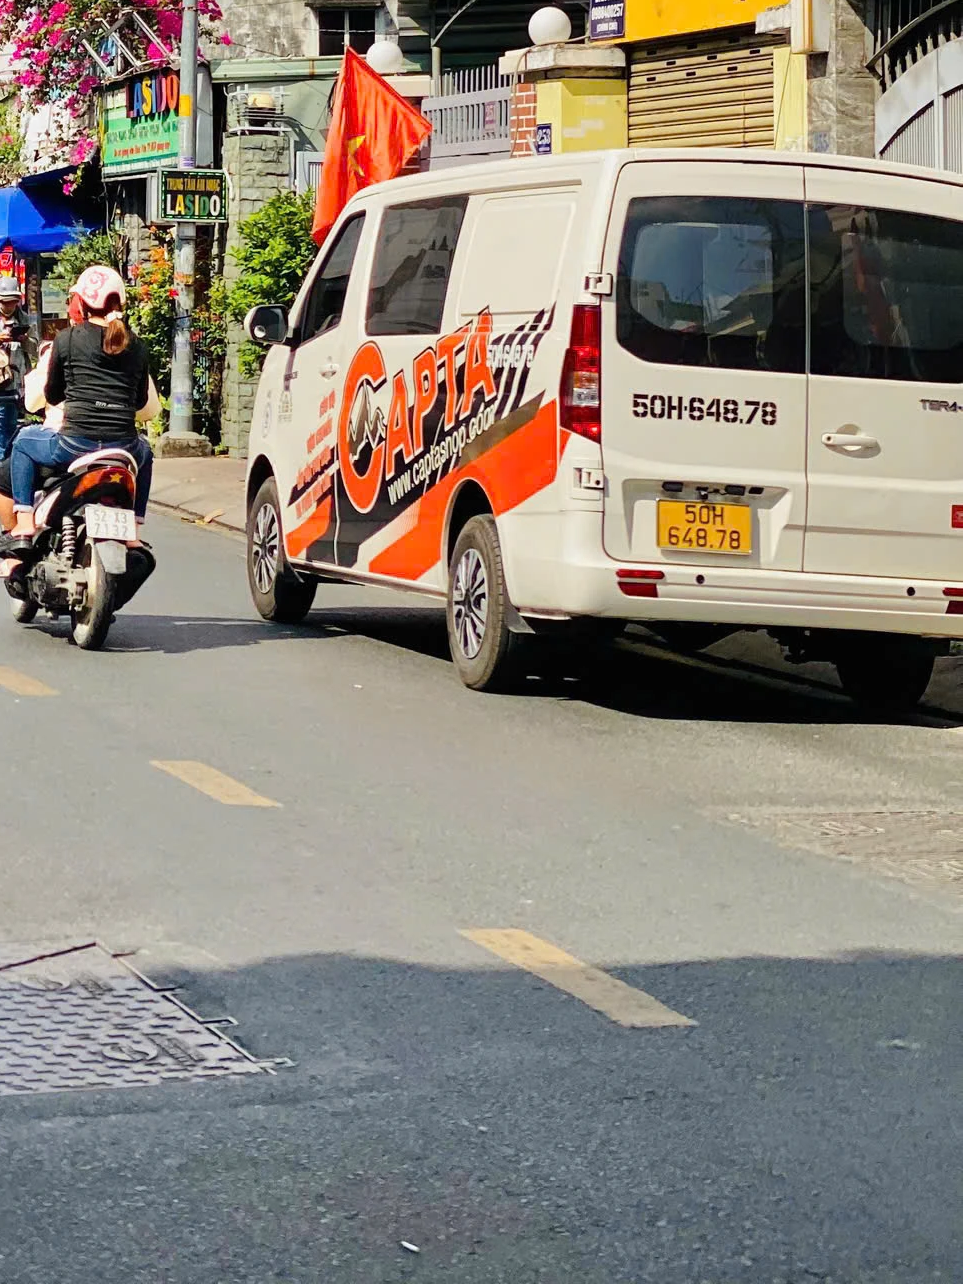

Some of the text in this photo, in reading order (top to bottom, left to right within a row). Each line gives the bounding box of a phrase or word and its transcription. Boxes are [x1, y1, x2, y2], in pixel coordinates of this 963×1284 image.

[125, 74, 180, 118] LASIDO
[166, 193, 221, 217] LASIDO
[338, 305, 497, 514] CAPTA
[684, 504, 725, 525] 50H
[668, 526, 741, 549] 648.78
